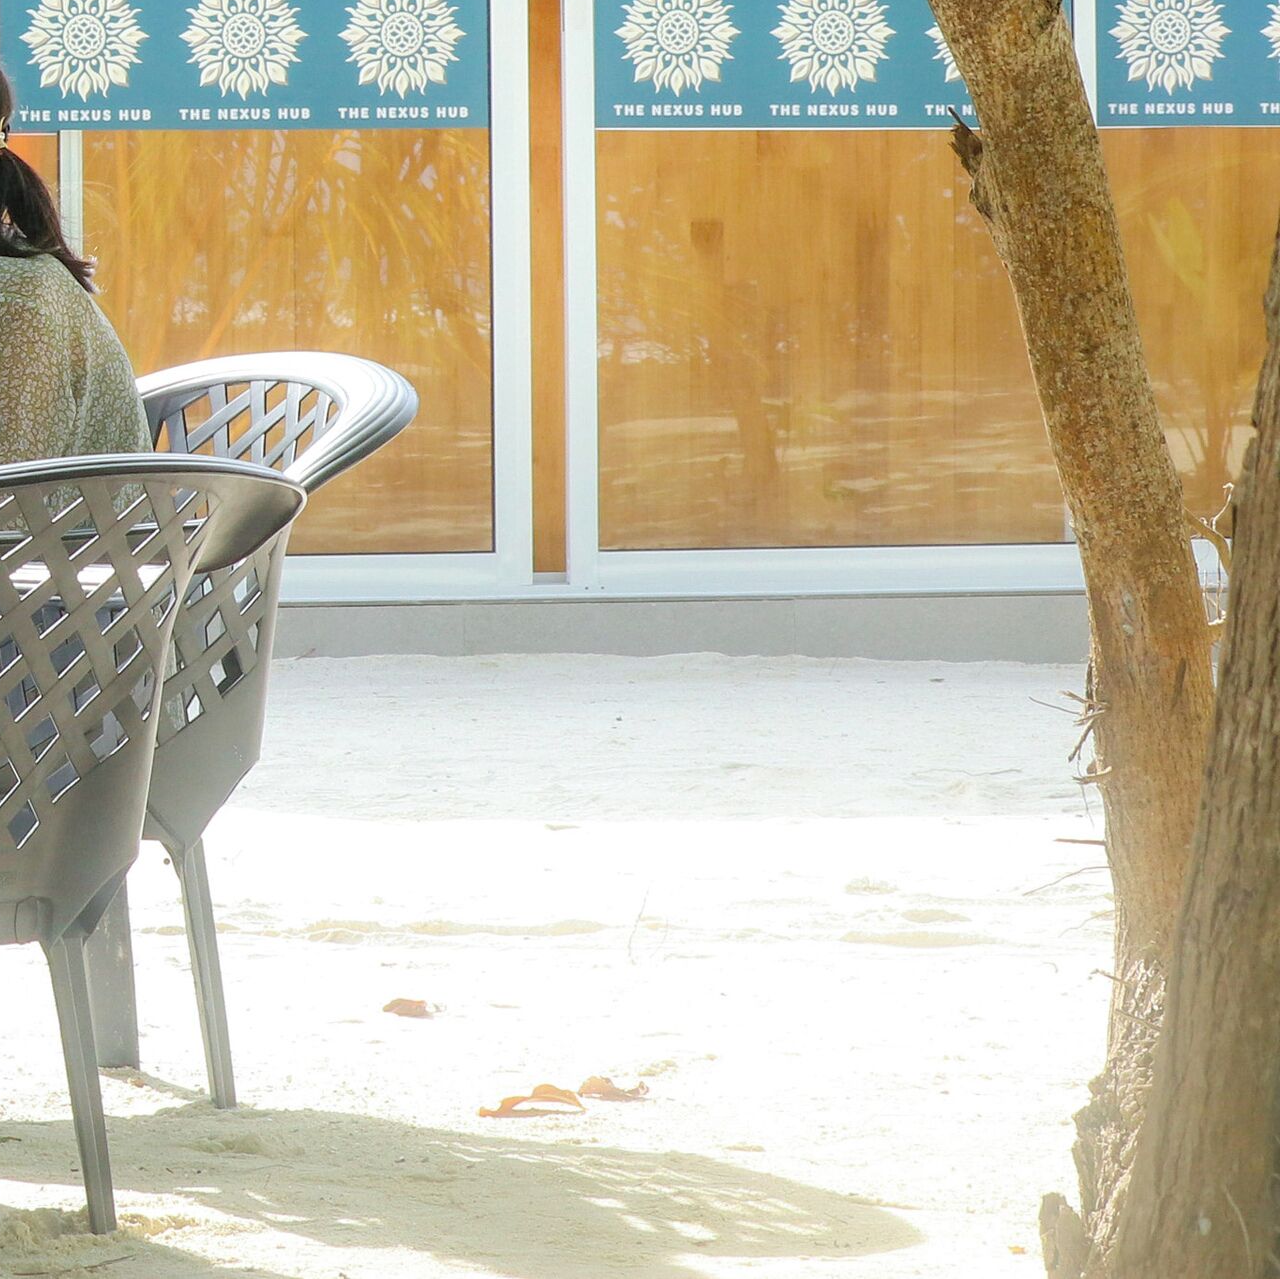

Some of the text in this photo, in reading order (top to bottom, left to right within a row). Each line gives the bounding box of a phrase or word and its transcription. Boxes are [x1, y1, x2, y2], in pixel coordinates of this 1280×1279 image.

[178, 107, 311, 121] THE NEXUS HUB
[337, 105, 469, 119] THE NEXUS HUB
[613, 104, 743, 116] THE NEXUS HUB
[769, 104, 898, 116] THE NEXUS HUB
[1108, 102, 1234, 115] THE NEXUS HUB
[1259, 102, 1280, 114] TH
[19, 108, 152, 122] THE NEXUS HUB
